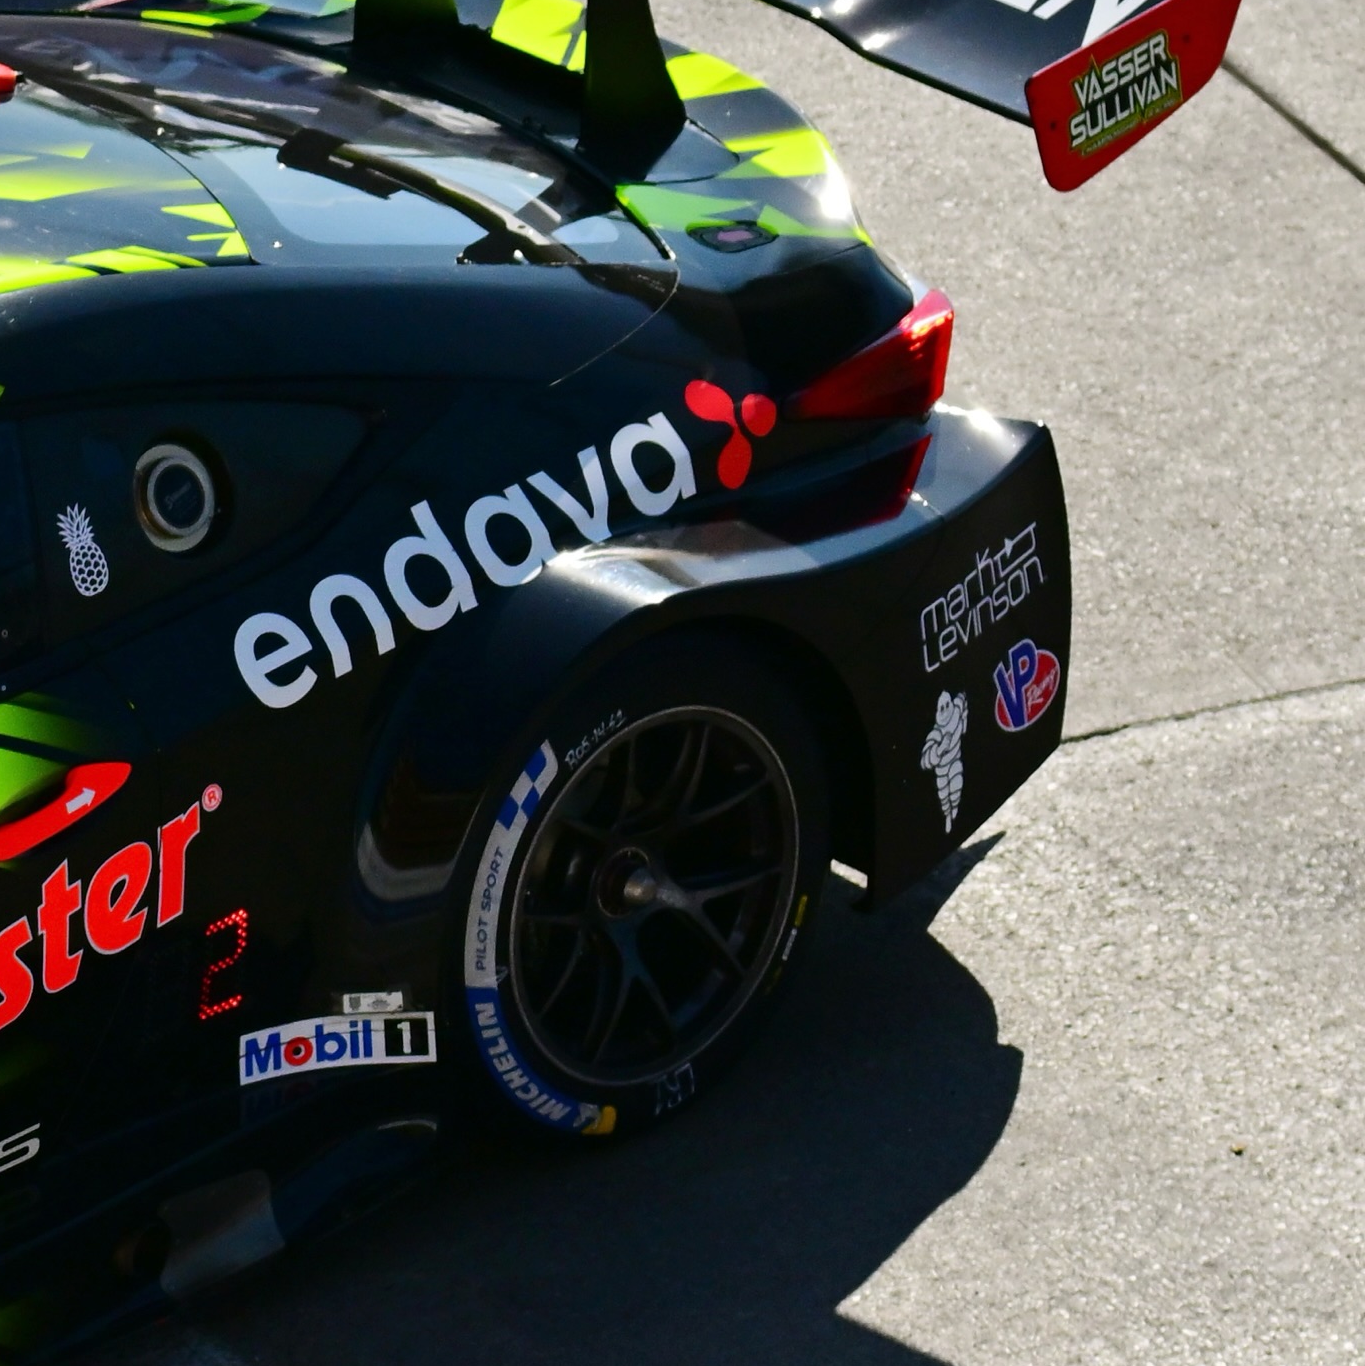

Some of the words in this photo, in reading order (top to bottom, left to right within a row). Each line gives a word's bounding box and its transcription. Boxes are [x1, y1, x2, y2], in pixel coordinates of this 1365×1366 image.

[1071, 62, 1177, 147] SULLIVAN
[1074, 34, 1166, 110] VASSER
[234, 412, 697, 709] endava
[994, 638, 1038, 728] VP
[481, 846, 504, 912] SPORT
[475, 916, 489, 971] PILOT
[244, 1020, 373, 1077] Mobil
[396, 1021, 413, 1054] 1
[475, 1002, 572, 1122] MICHELIN
